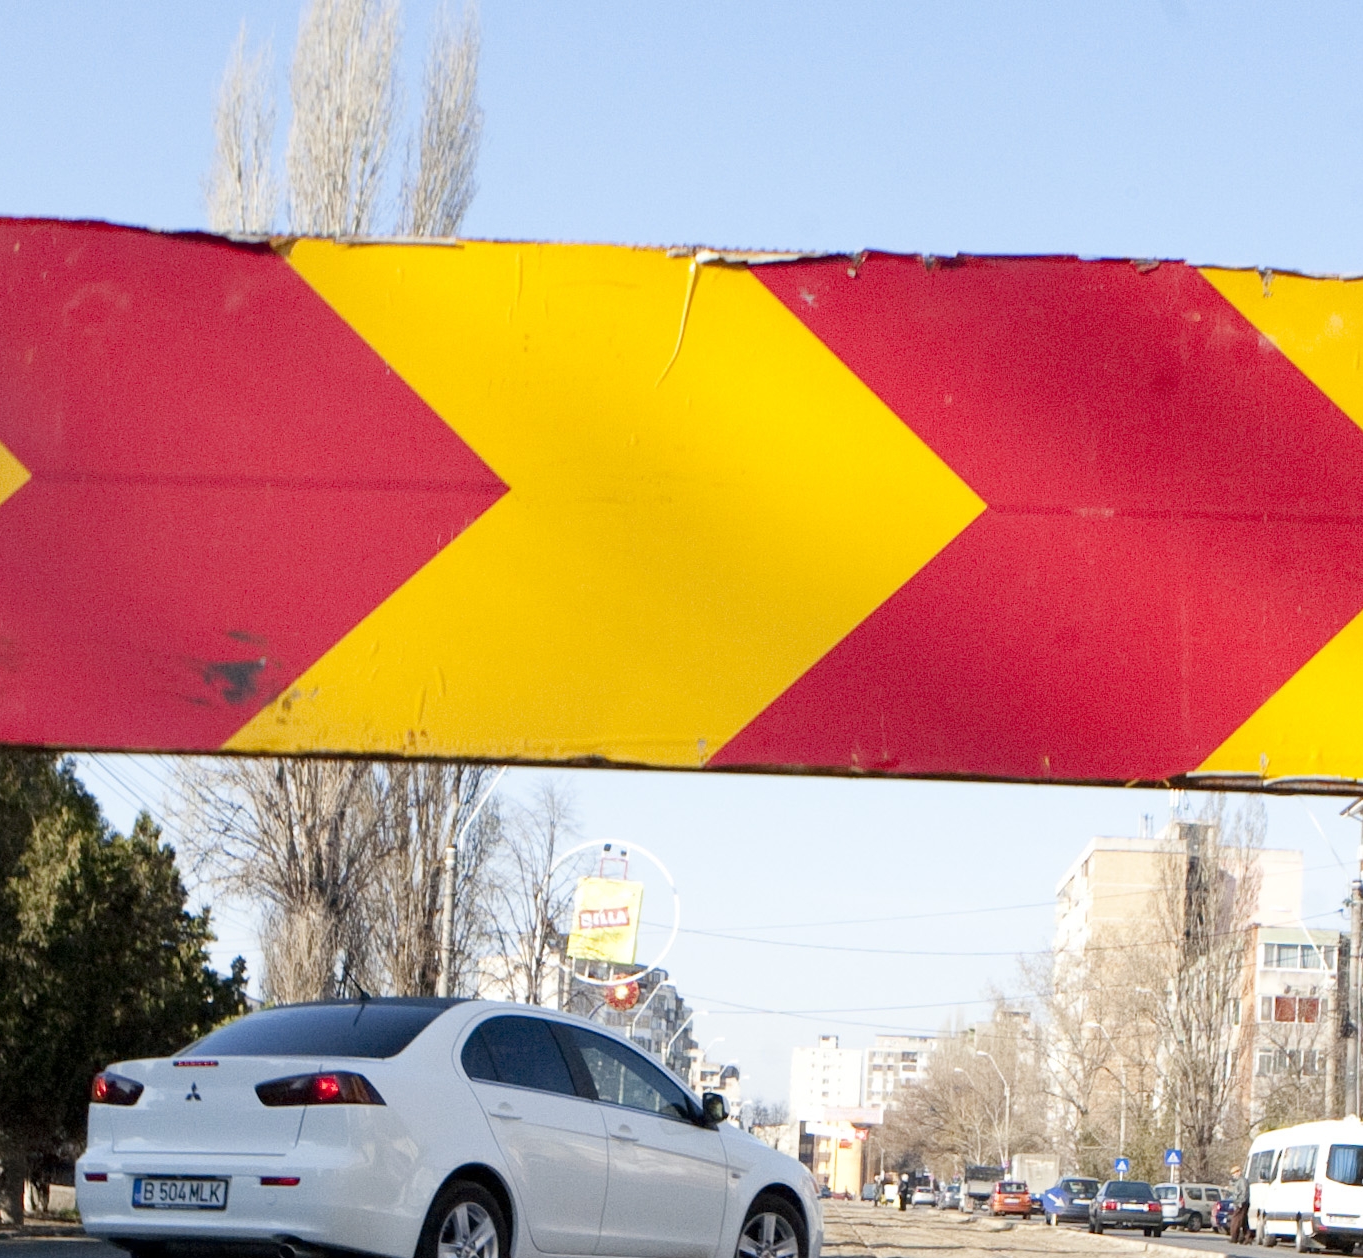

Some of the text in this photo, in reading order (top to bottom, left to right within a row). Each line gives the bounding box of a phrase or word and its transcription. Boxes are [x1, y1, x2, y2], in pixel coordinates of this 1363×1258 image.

[580, 910, 628, 927] BILLA
[144, 1182, 220, 1203] B 504 MLK
